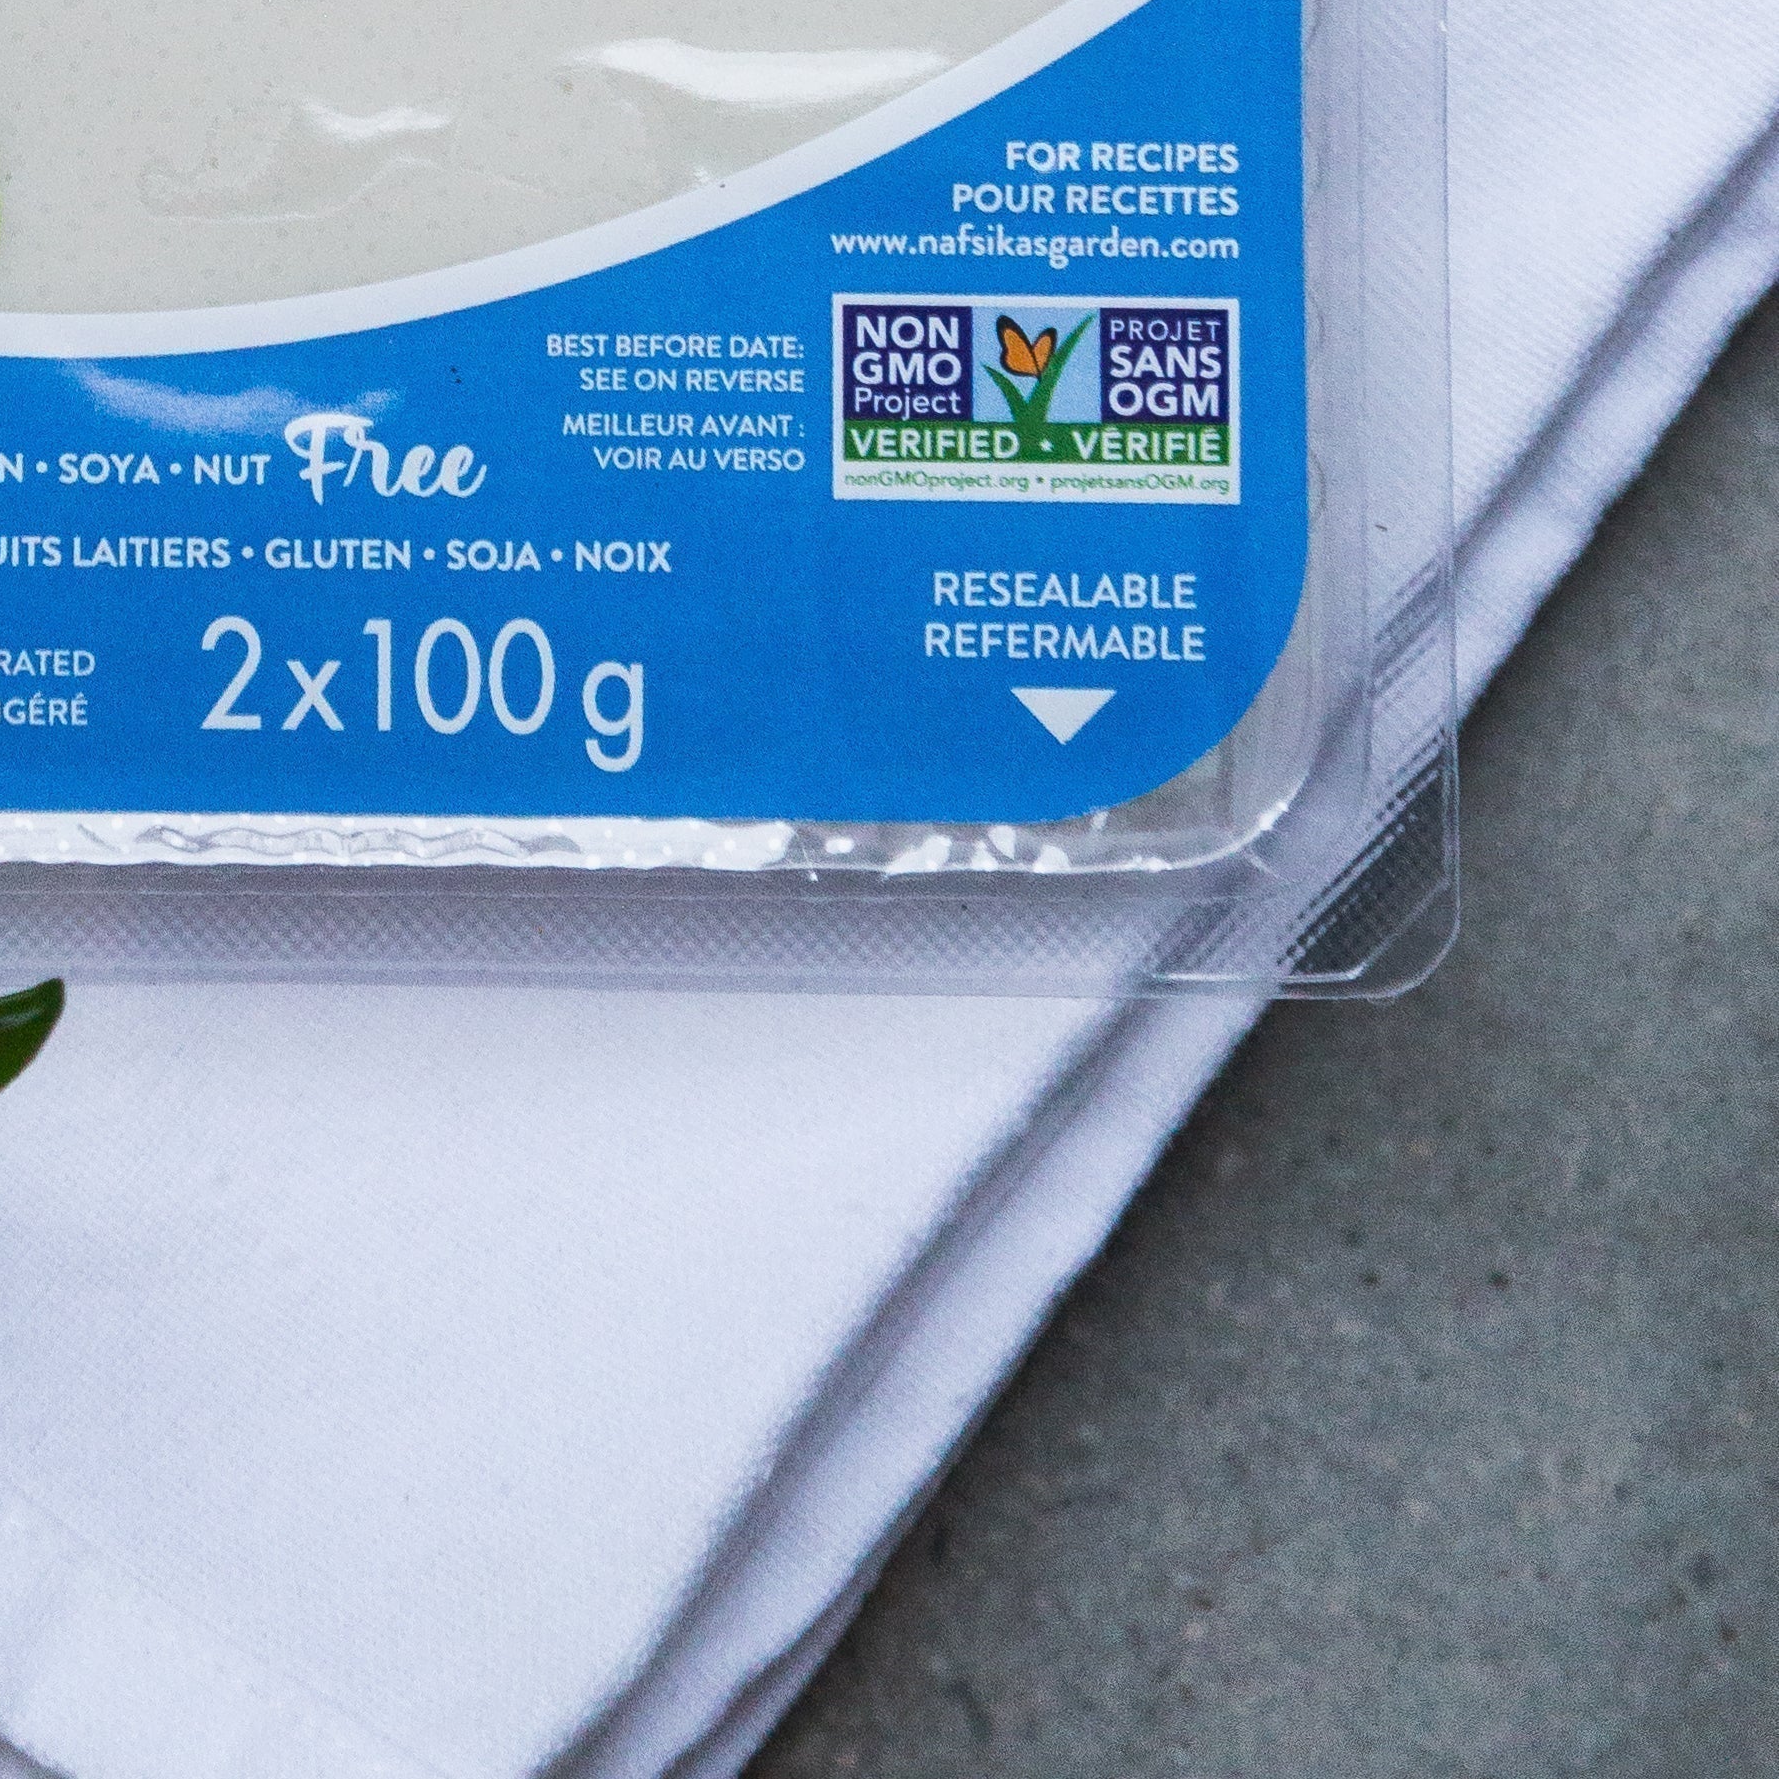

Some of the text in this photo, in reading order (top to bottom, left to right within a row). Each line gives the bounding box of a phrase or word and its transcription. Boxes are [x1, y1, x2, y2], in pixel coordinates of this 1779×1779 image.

[1005, 142, 1240, 174] FOR RECIPES
[952, 184, 1240, 216] POUR RECETTES
[830, 223, 1240, 270] www.nafsikasgarden.com
[546, 334, 804, 359] BEST BEFORE DATE:
[856, 316, 960, 349] NON
[1110, 320, 1222, 342] PROJET
[853, 353, 963, 386] GMO
[1109, 347, 1222, 379] SANS
[579, 368, 805, 393] SEE ON REVERSE
[854, 387, 962, 420] Project
[1108, 383, 1220, 418] OGM
[562, 413, 694, 437] MEILLEUR
[58, 453, 160, 485] SOYA
[193, 454, 271, 485] NUT
[284, 413, 488, 505] Free
[593, 446, 806, 472] VOIR AU VERSO
[850, 429, 1019, 458] VERIFIED
[844, 471, 1230, 495] nonGMOproject.org projetsansOGM.org
[73, 535, 231, 569] LAITIERS
[264, 537, 411, 571] GLUTEN
[446, 540, 542, 572] SOJA
[575, 541, 673, 573] NOIX
[933, 572, 1197, 610] RESEALABLE
[925, 624, 1206, 662] REFERMABLE
